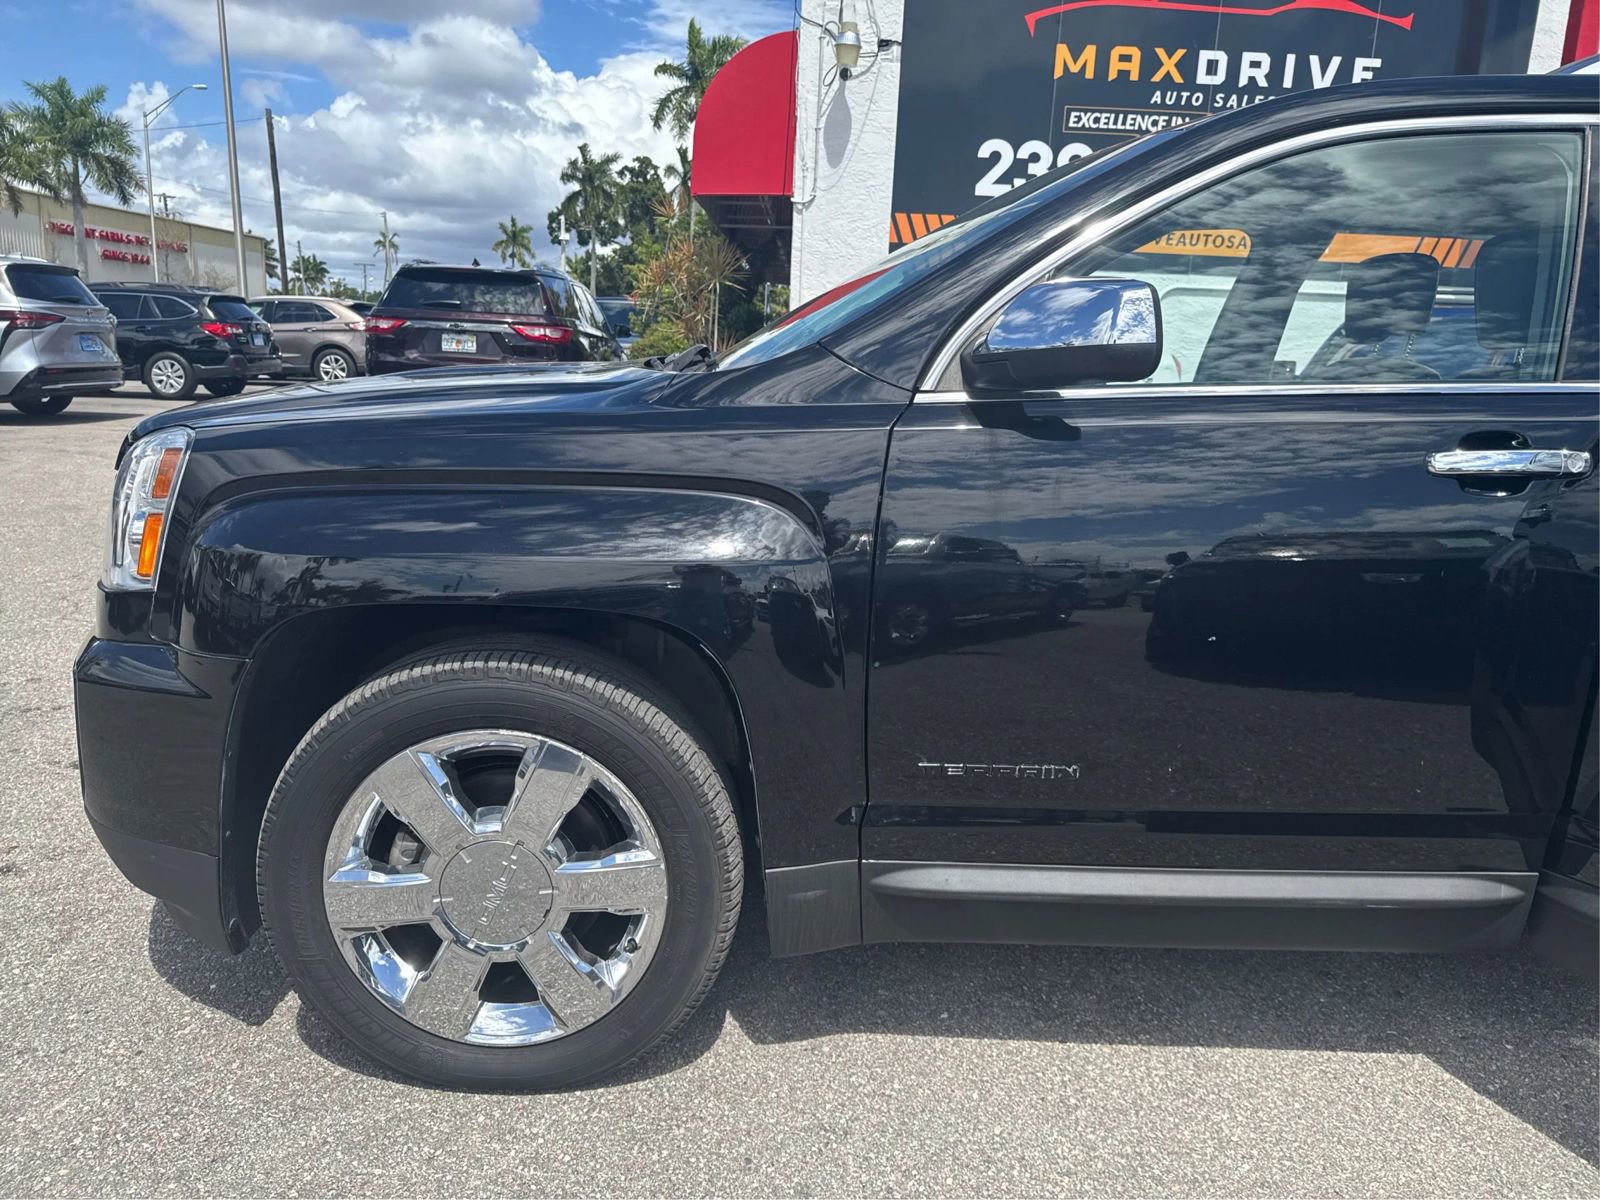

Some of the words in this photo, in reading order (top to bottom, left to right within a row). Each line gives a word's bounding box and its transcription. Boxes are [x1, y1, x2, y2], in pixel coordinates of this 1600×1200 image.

[1053, 43, 1382, 89] MAXDRIVE
[1150, 90, 1204, 106] AUTO
[1213, 93, 1276, 109] SALE
[1068, 111, 1169, 133] EXCELLENCE
[917, 761, 1080, 779] TERRAIN
